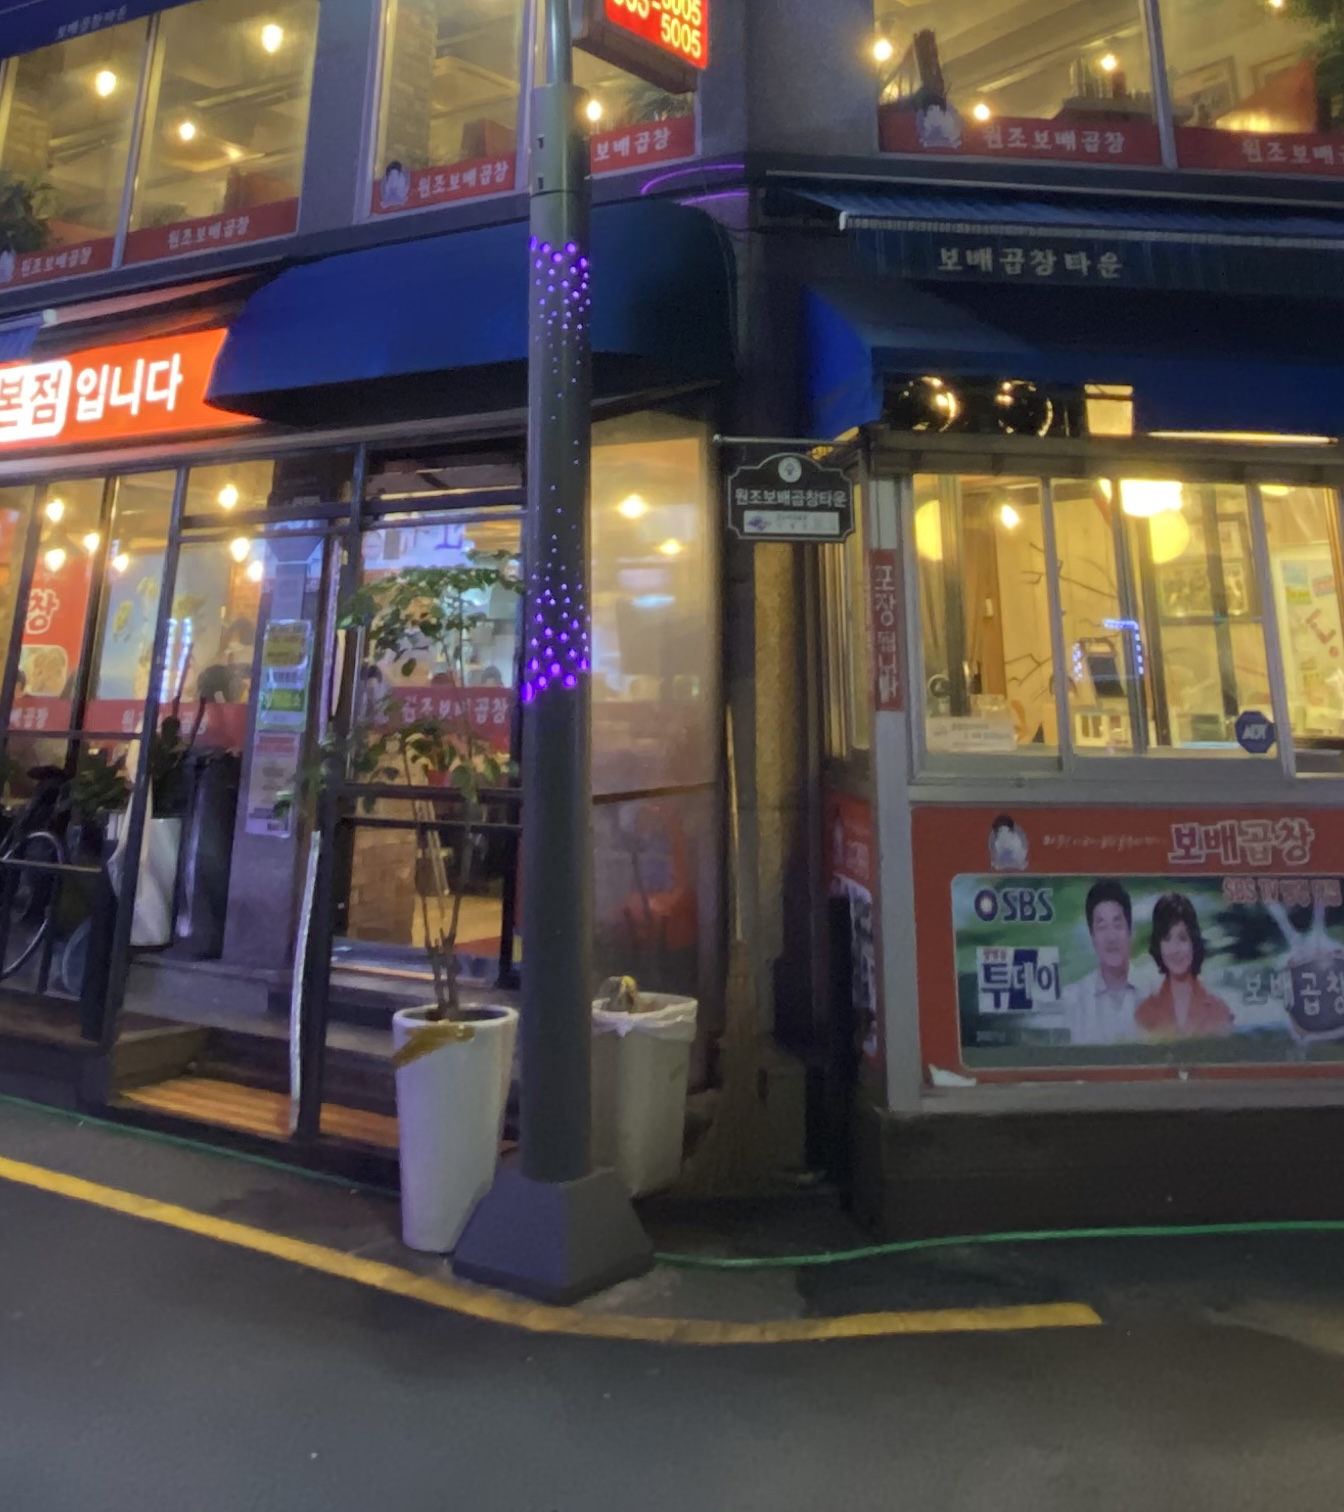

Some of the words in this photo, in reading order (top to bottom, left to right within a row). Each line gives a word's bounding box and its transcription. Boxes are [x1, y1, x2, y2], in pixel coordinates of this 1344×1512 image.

[661, 16, 702, 60] 5005
[937, 246, 1124, 279] 보배곱창타운
[74, 351, 185, 425] 입니다
[735, 488, 848, 508] 원조보배곱창타운
[1167, 818, 1315, 866] 보배곱창
[1002, 889, 1054, 922] SBS
